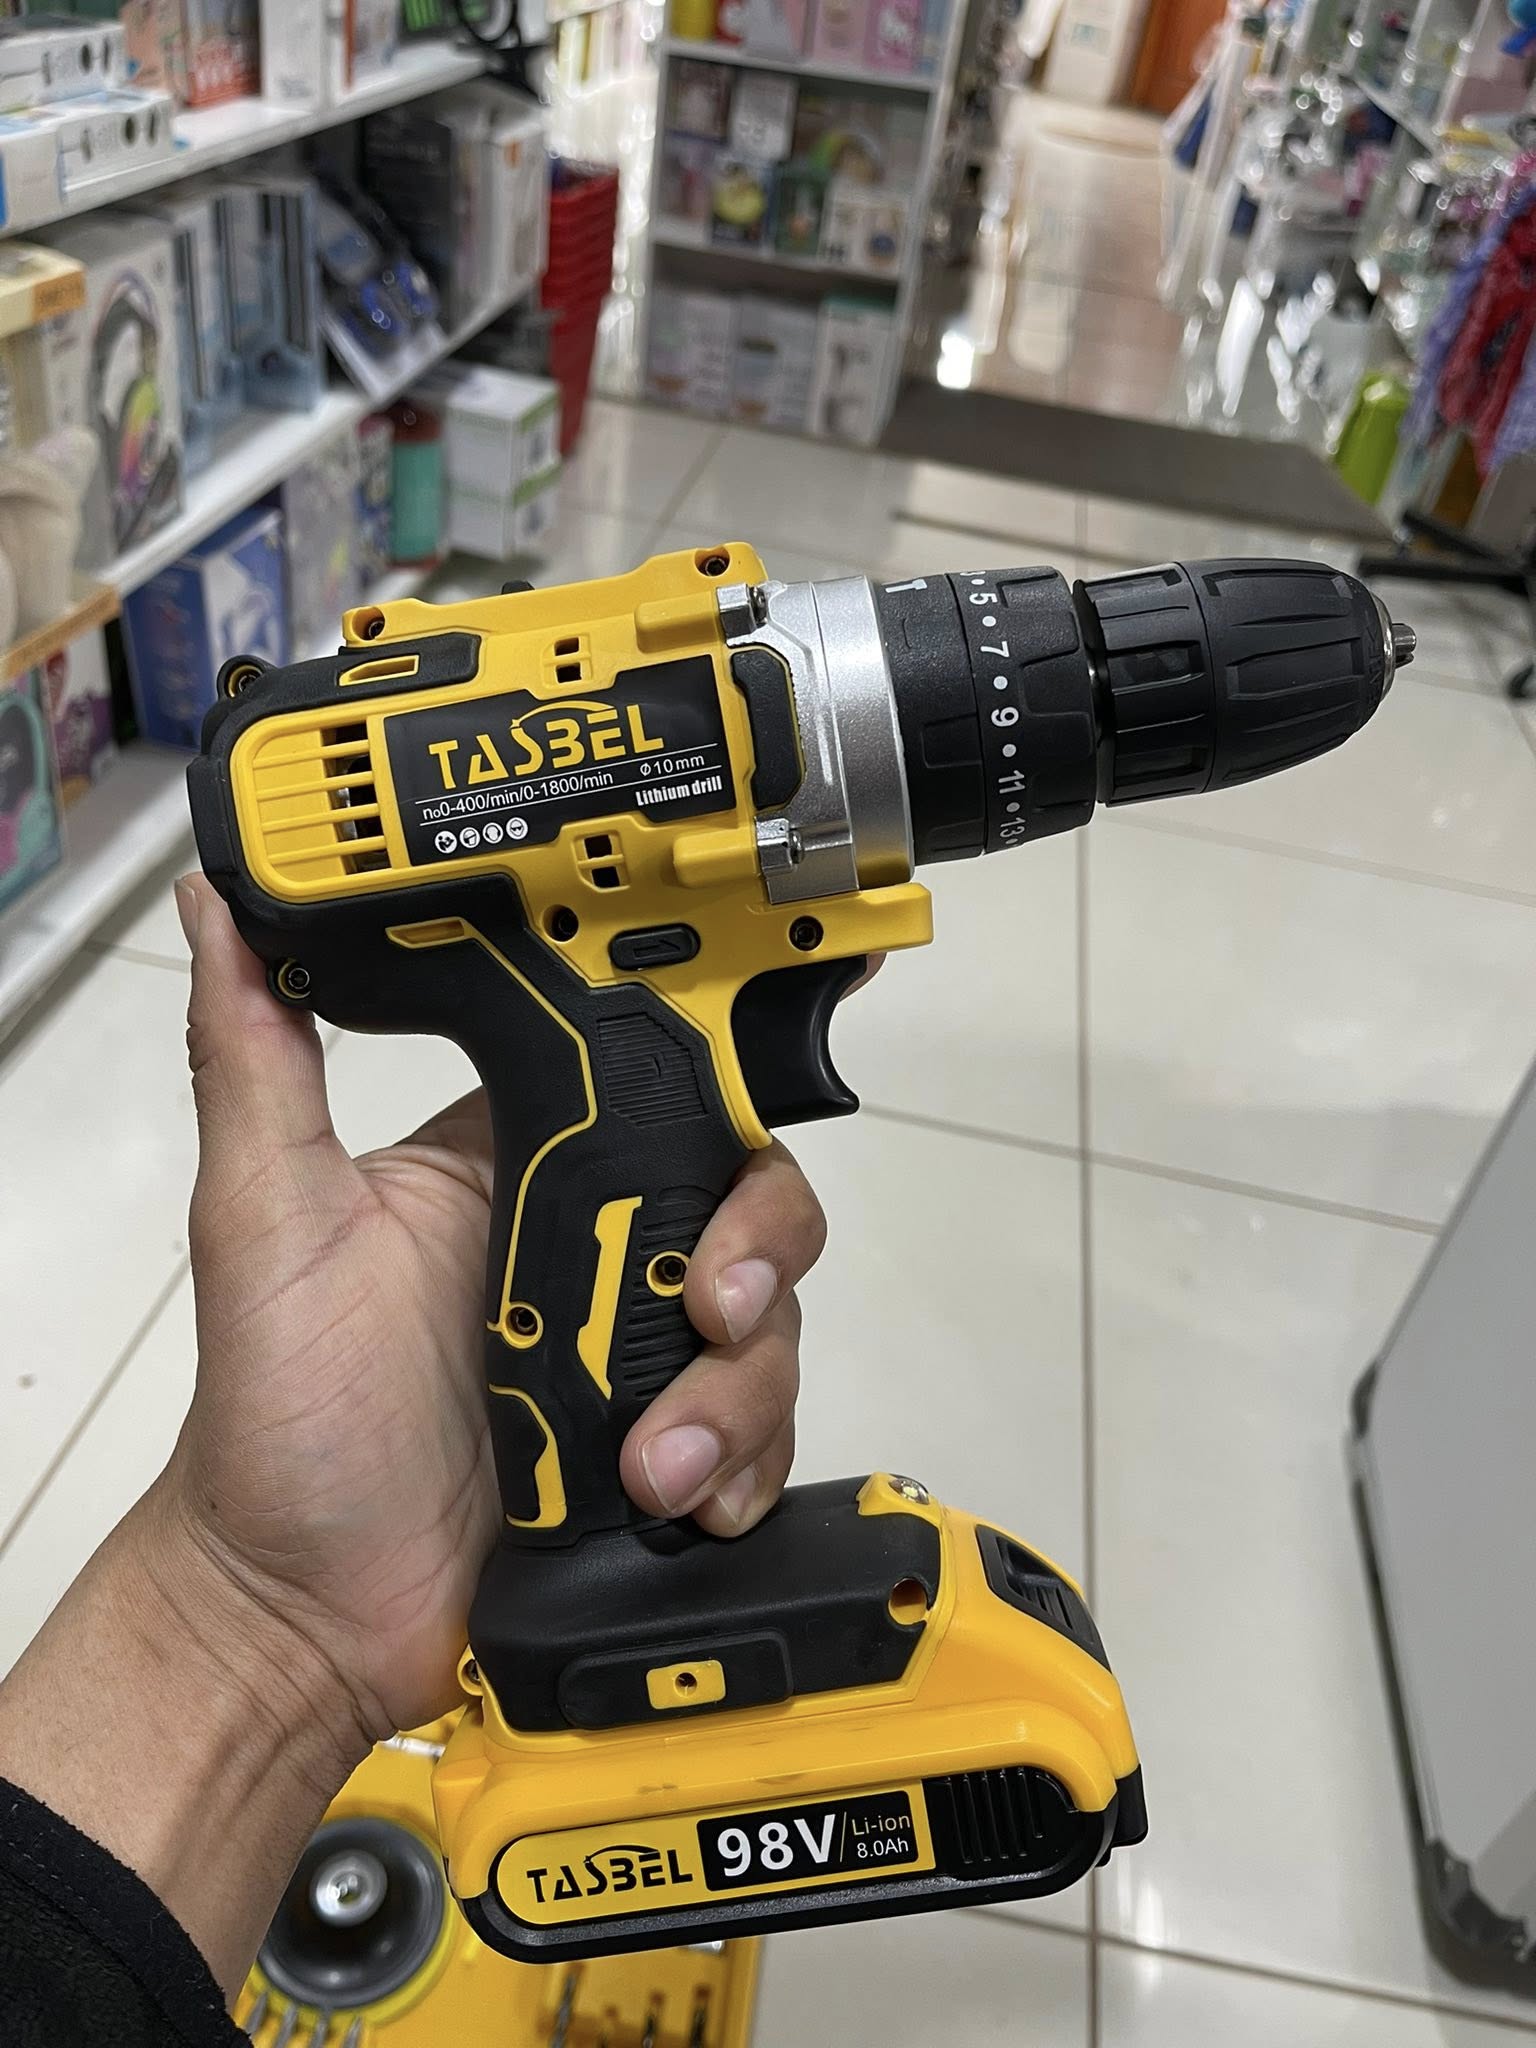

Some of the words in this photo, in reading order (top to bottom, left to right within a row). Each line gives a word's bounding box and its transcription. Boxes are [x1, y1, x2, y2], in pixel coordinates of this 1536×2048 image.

[969, 592, 998, 606] 5
[980, 640, 1010, 659] 7
[990, 706, 1020, 727] 9
[428, 700, 664, 790] TASBEL
[635, 784, 691, 807] Lithium
[691, 775, 723, 796] drill
[998, 769, 1026, 794] 11
[999, 817, 1027, 839] 13
[851, 1814, 911, 1836] Li-ion
[856, 1837, 909, 1859] 8.0Ah
[526, 1844, 694, 1904] TASBEL
